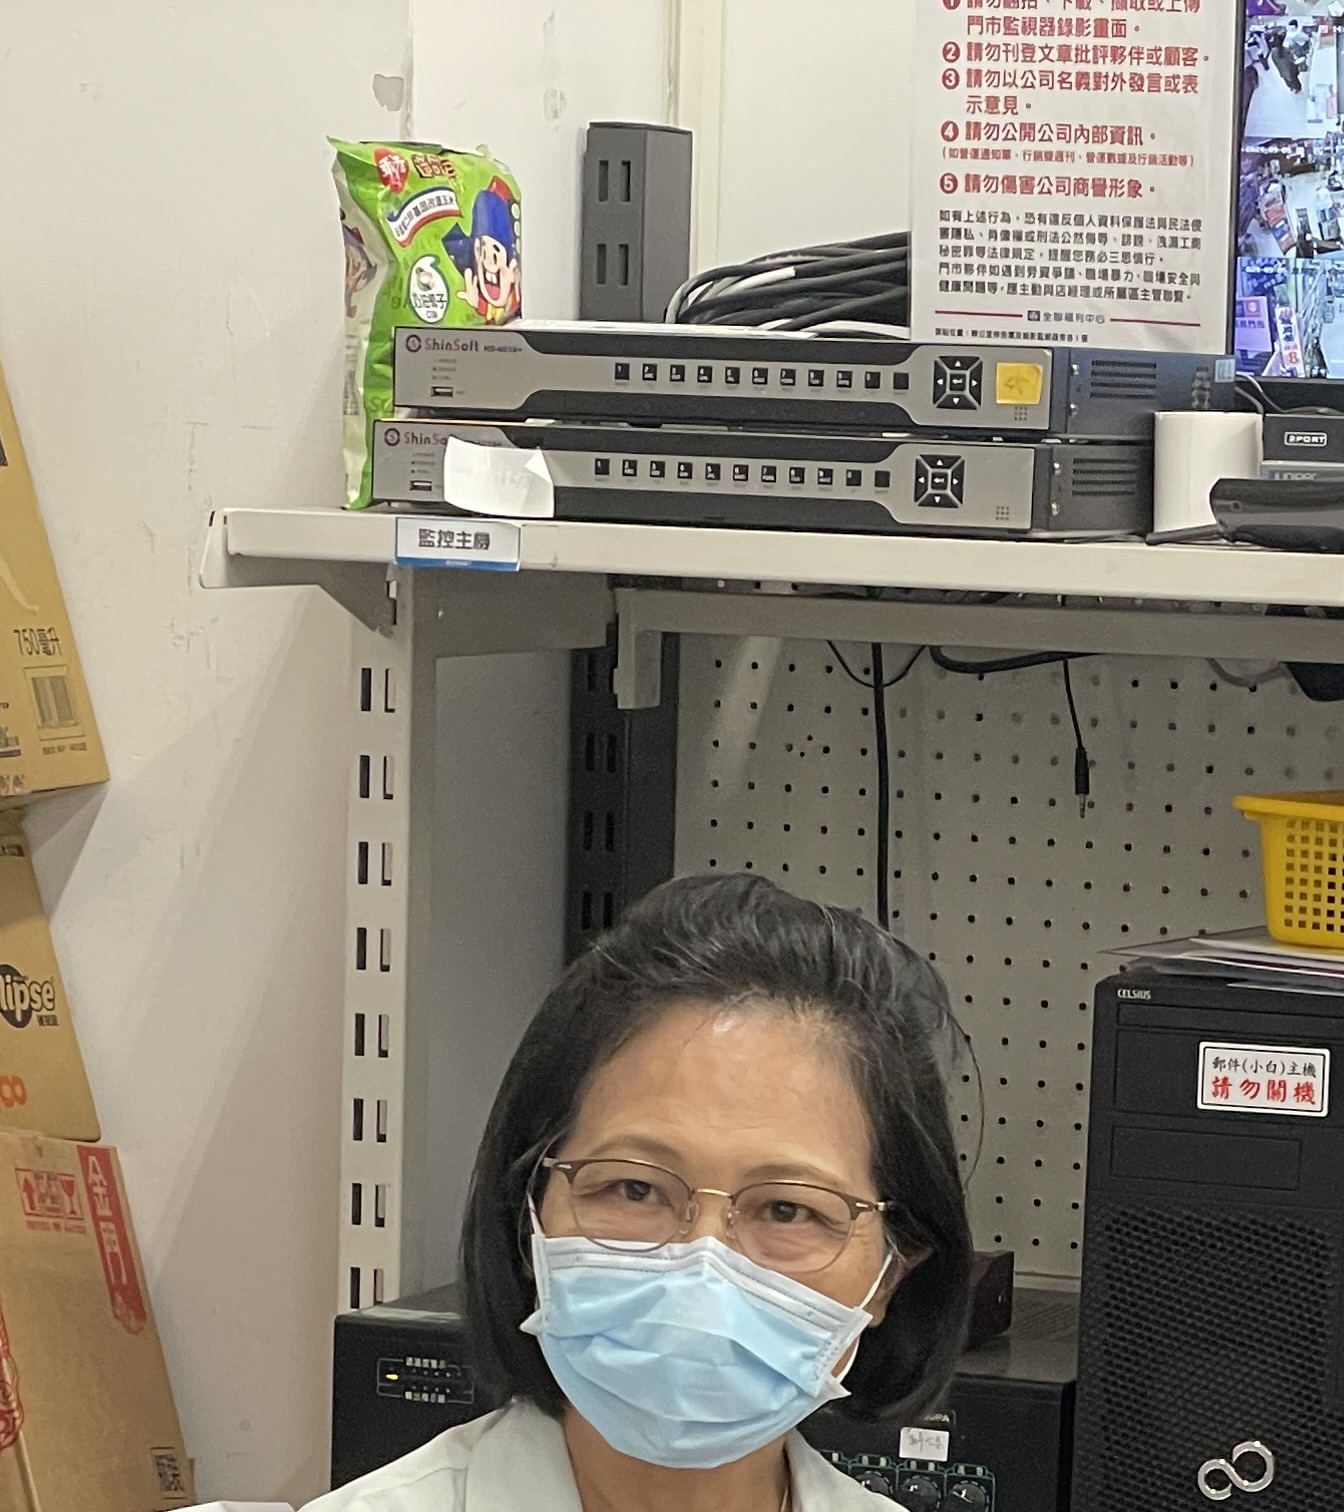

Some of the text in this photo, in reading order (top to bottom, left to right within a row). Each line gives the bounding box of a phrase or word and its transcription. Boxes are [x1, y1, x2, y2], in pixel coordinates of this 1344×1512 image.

[404, 433, 447, 445] ShinSo
[418, 530, 491, 551] 監控主機
[1117, 989, 1151, 1000] CELSIUS
[1211, 1055, 1317, 1079] 郵件(小白)主機
[1211, 1076, 1316, 1105] 請勿關機
